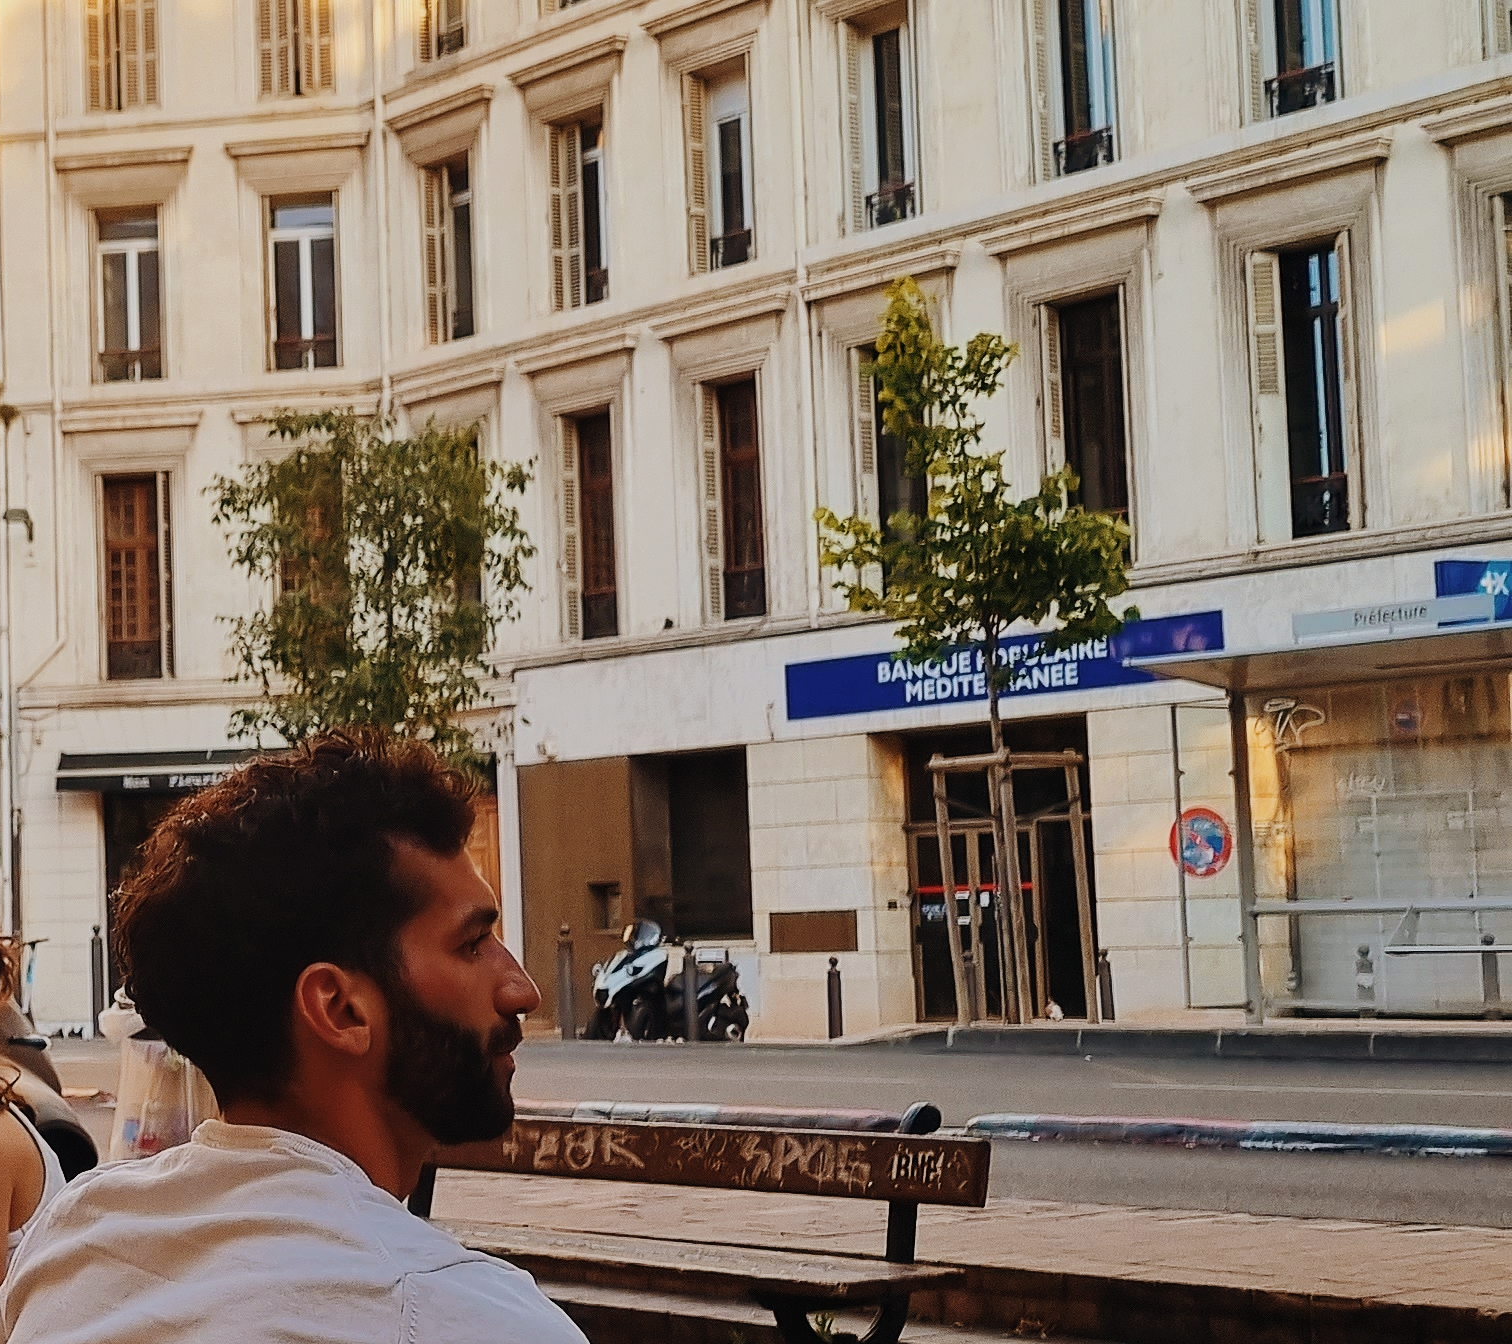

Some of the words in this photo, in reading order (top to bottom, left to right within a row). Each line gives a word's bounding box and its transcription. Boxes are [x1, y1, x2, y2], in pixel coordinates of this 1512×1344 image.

[1354, 606, 1427, 626] Préfecture
[877, 649, 972, 684] BANQUE
[905, 662, 1079, 703] MEDITEANEE
